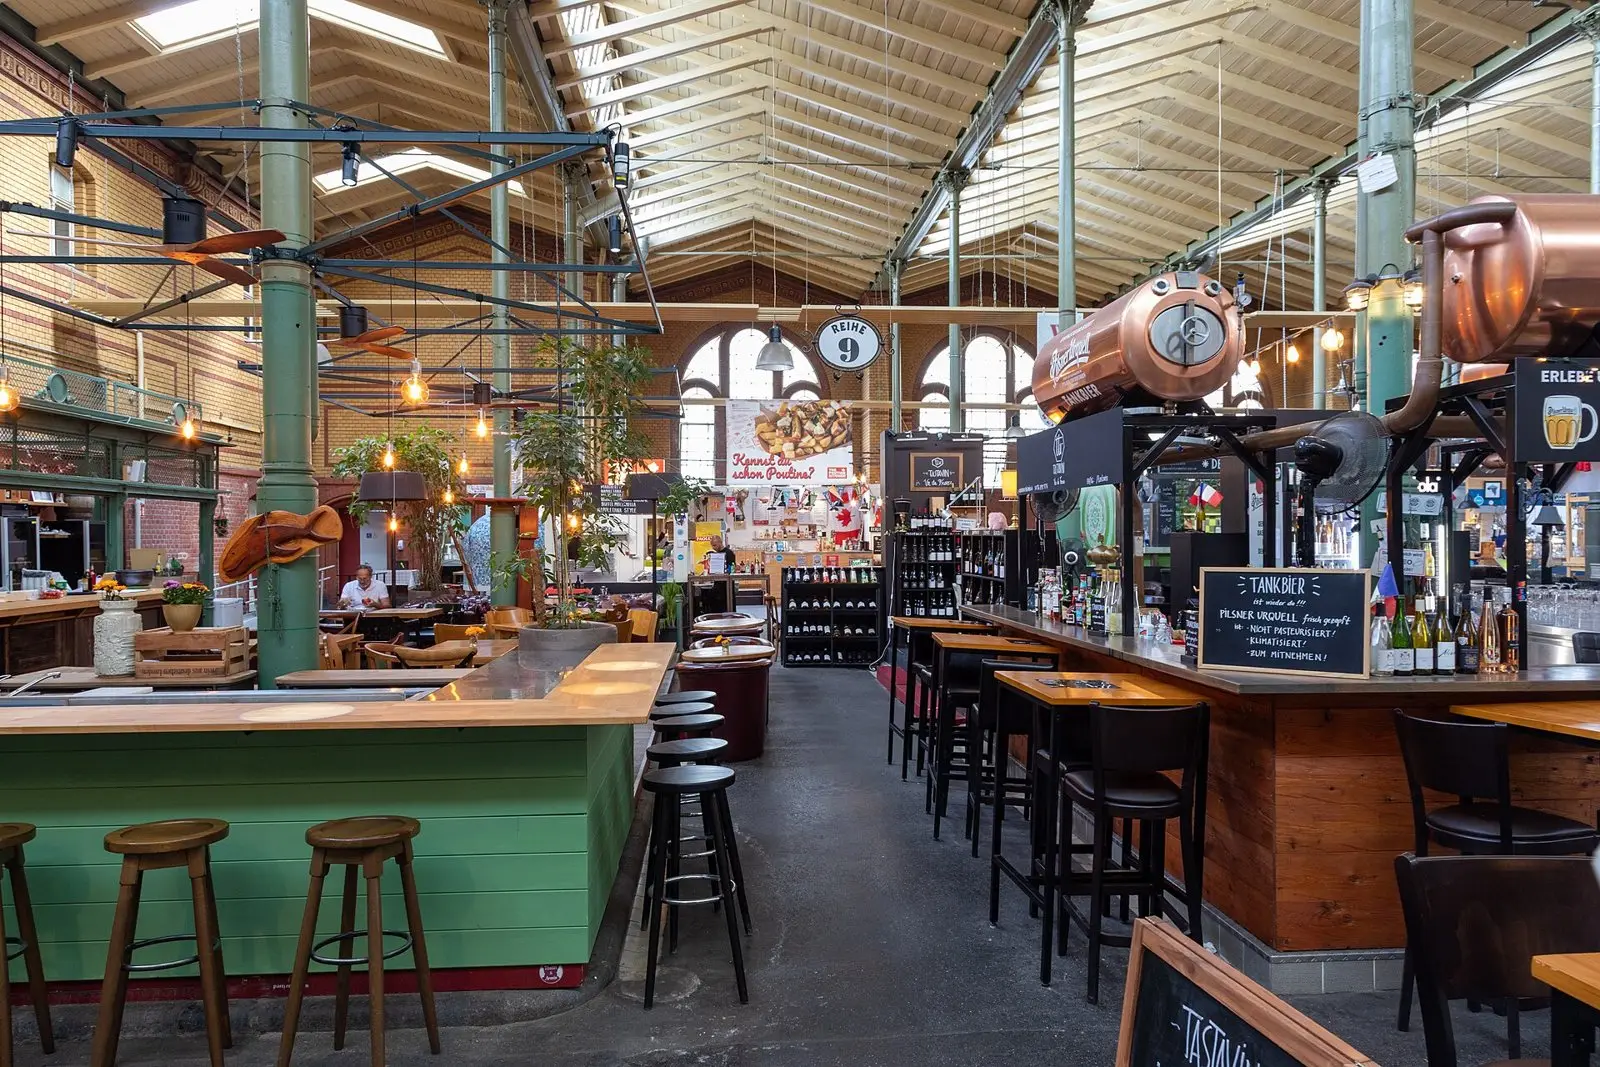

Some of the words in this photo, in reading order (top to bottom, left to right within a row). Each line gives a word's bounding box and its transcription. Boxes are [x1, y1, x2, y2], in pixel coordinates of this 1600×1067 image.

[831, 321, 867, 335] REIHE
[838, 337, 860, 363] 9
[1061, 383, 1103, 406] TANKBIER
[732, 453, 776, 467] Kennst
[777, 456, 792, 467] du
[732, 466, 765, 480] schon
[765, 466, 815, 480] Poutine?
[1249, 575, 1305, 595] TANKBIER
[1220, 608, 1254, 620] PILSNER
[1257, 611, 1299, 623] URQUELL
[1302, 613, 1322, 625] frisch
[1273, 626, 1337, 638] PASTEURISIERT!
[1270, 650, 1328, 662] MITNEHMEN!
